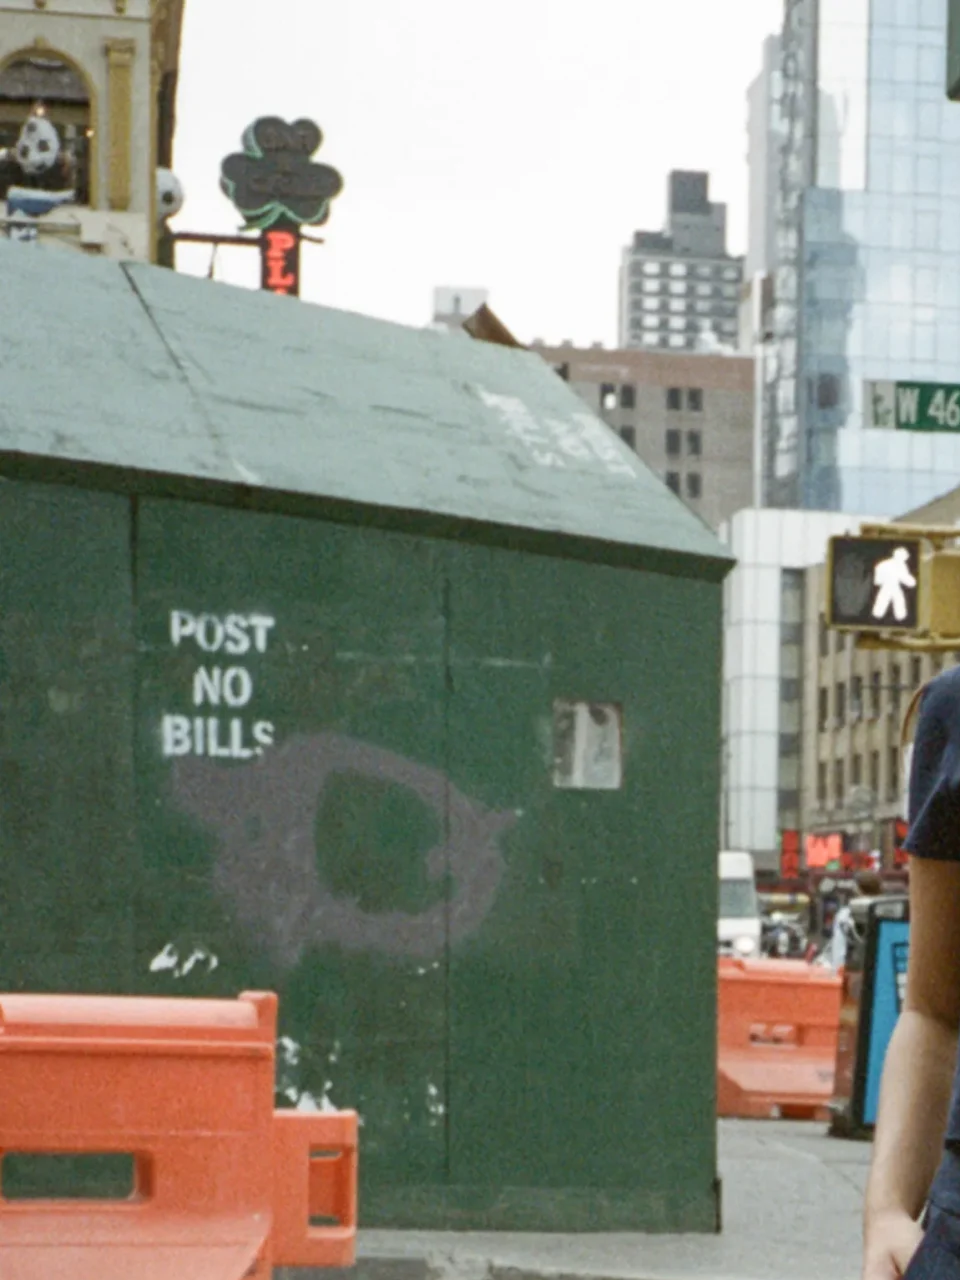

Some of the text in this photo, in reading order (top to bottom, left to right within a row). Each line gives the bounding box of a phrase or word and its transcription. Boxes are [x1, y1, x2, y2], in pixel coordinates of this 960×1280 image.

[265, 230, 297, 295] PL
[897, 387, 920, 425] W
[170, 610, 276, 655] POST
[193, 665, 253, 708] NO
[161, 713, 276, 759] BILLS
